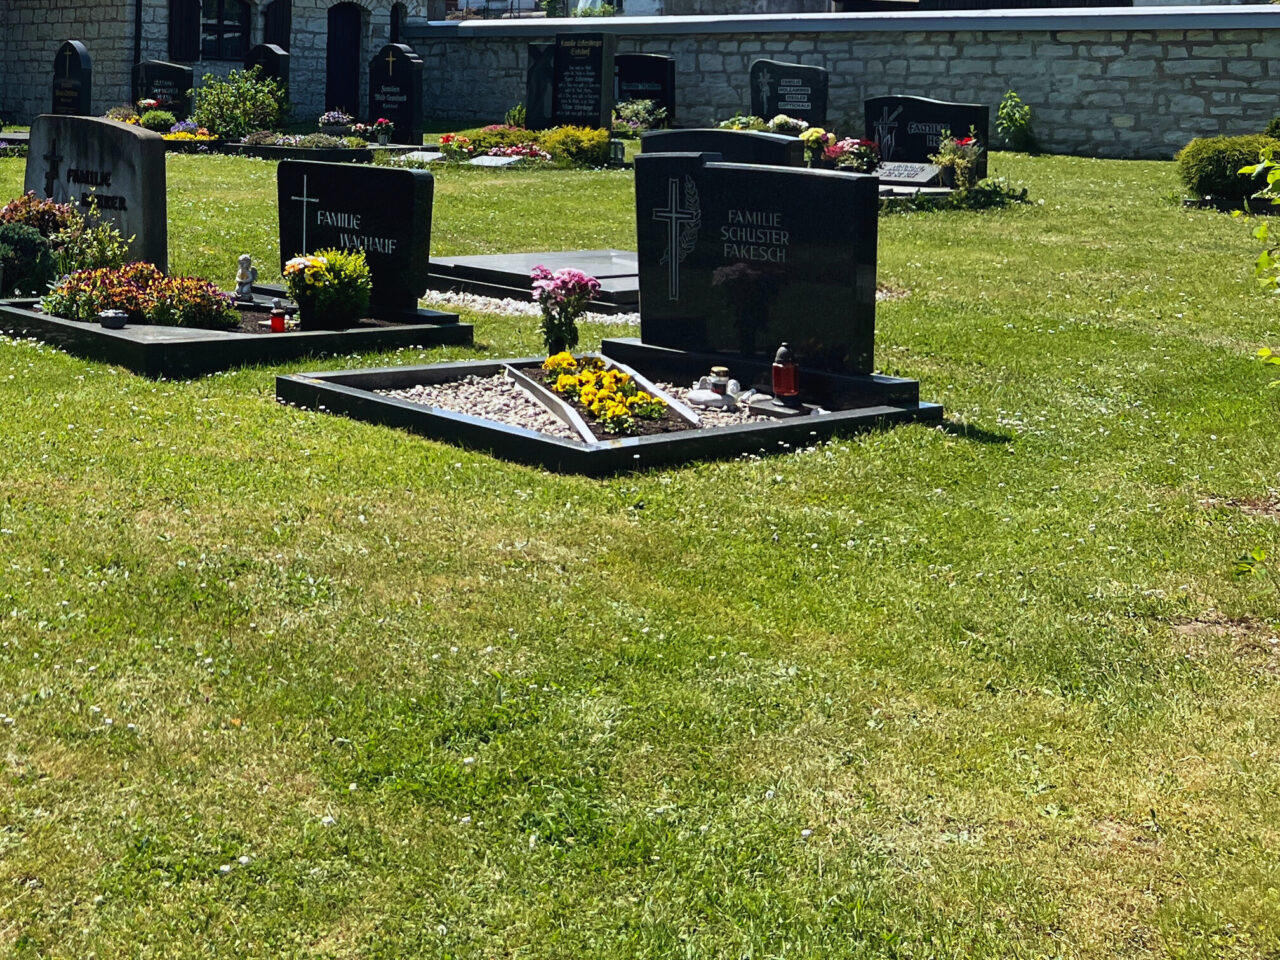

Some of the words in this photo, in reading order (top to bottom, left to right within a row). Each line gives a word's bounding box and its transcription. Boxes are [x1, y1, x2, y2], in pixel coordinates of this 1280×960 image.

[317, 210, 361, 230] FAMILIE
[728, 209, 782, 227] FAMILIE
[339, 233, 397, 254] WACHAUF
[721, 226, 789, 245] SCHUSTER
[723, 243, 786, 263] FAKESCH
